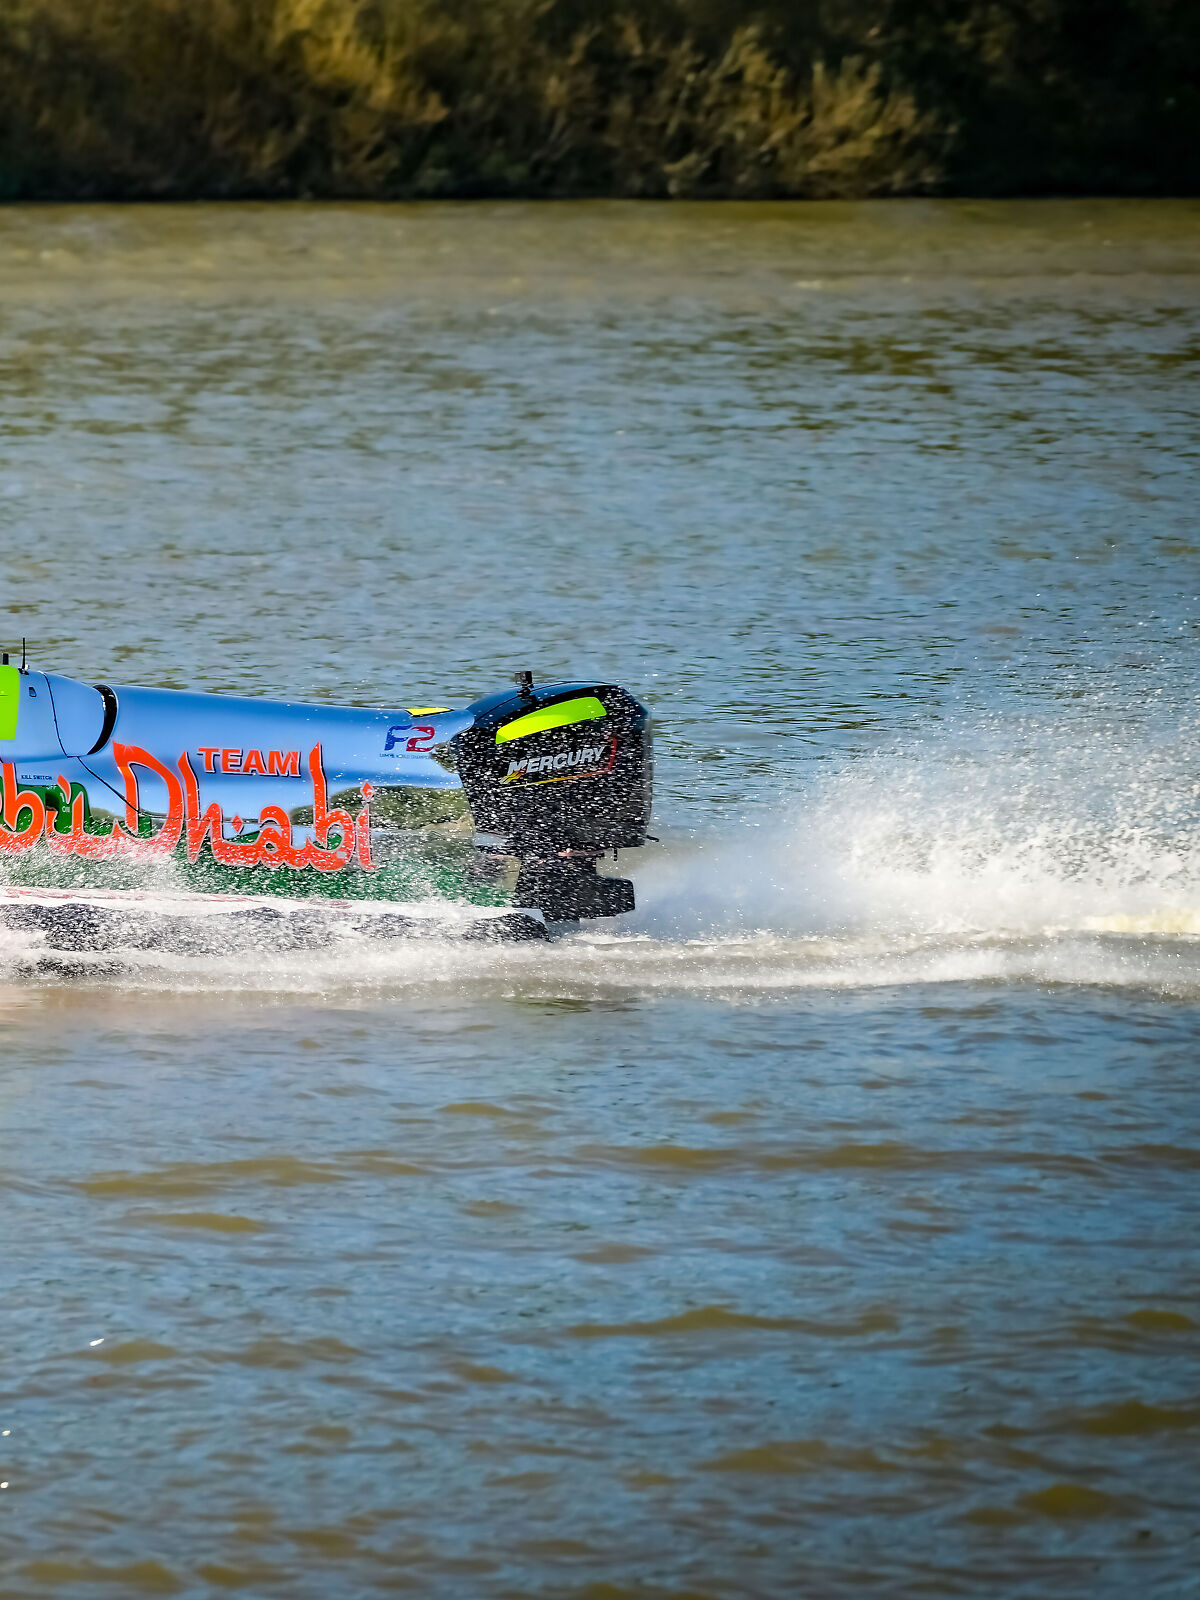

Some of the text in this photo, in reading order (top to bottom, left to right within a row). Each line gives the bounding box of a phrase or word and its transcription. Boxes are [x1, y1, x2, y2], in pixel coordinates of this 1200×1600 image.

[384, 724, 435, 752] F2
[198, 747, 301, 777] TEAM
[505, 746, 605, 777] MERCURY
[112, 741, 378, 873] Dhabi
